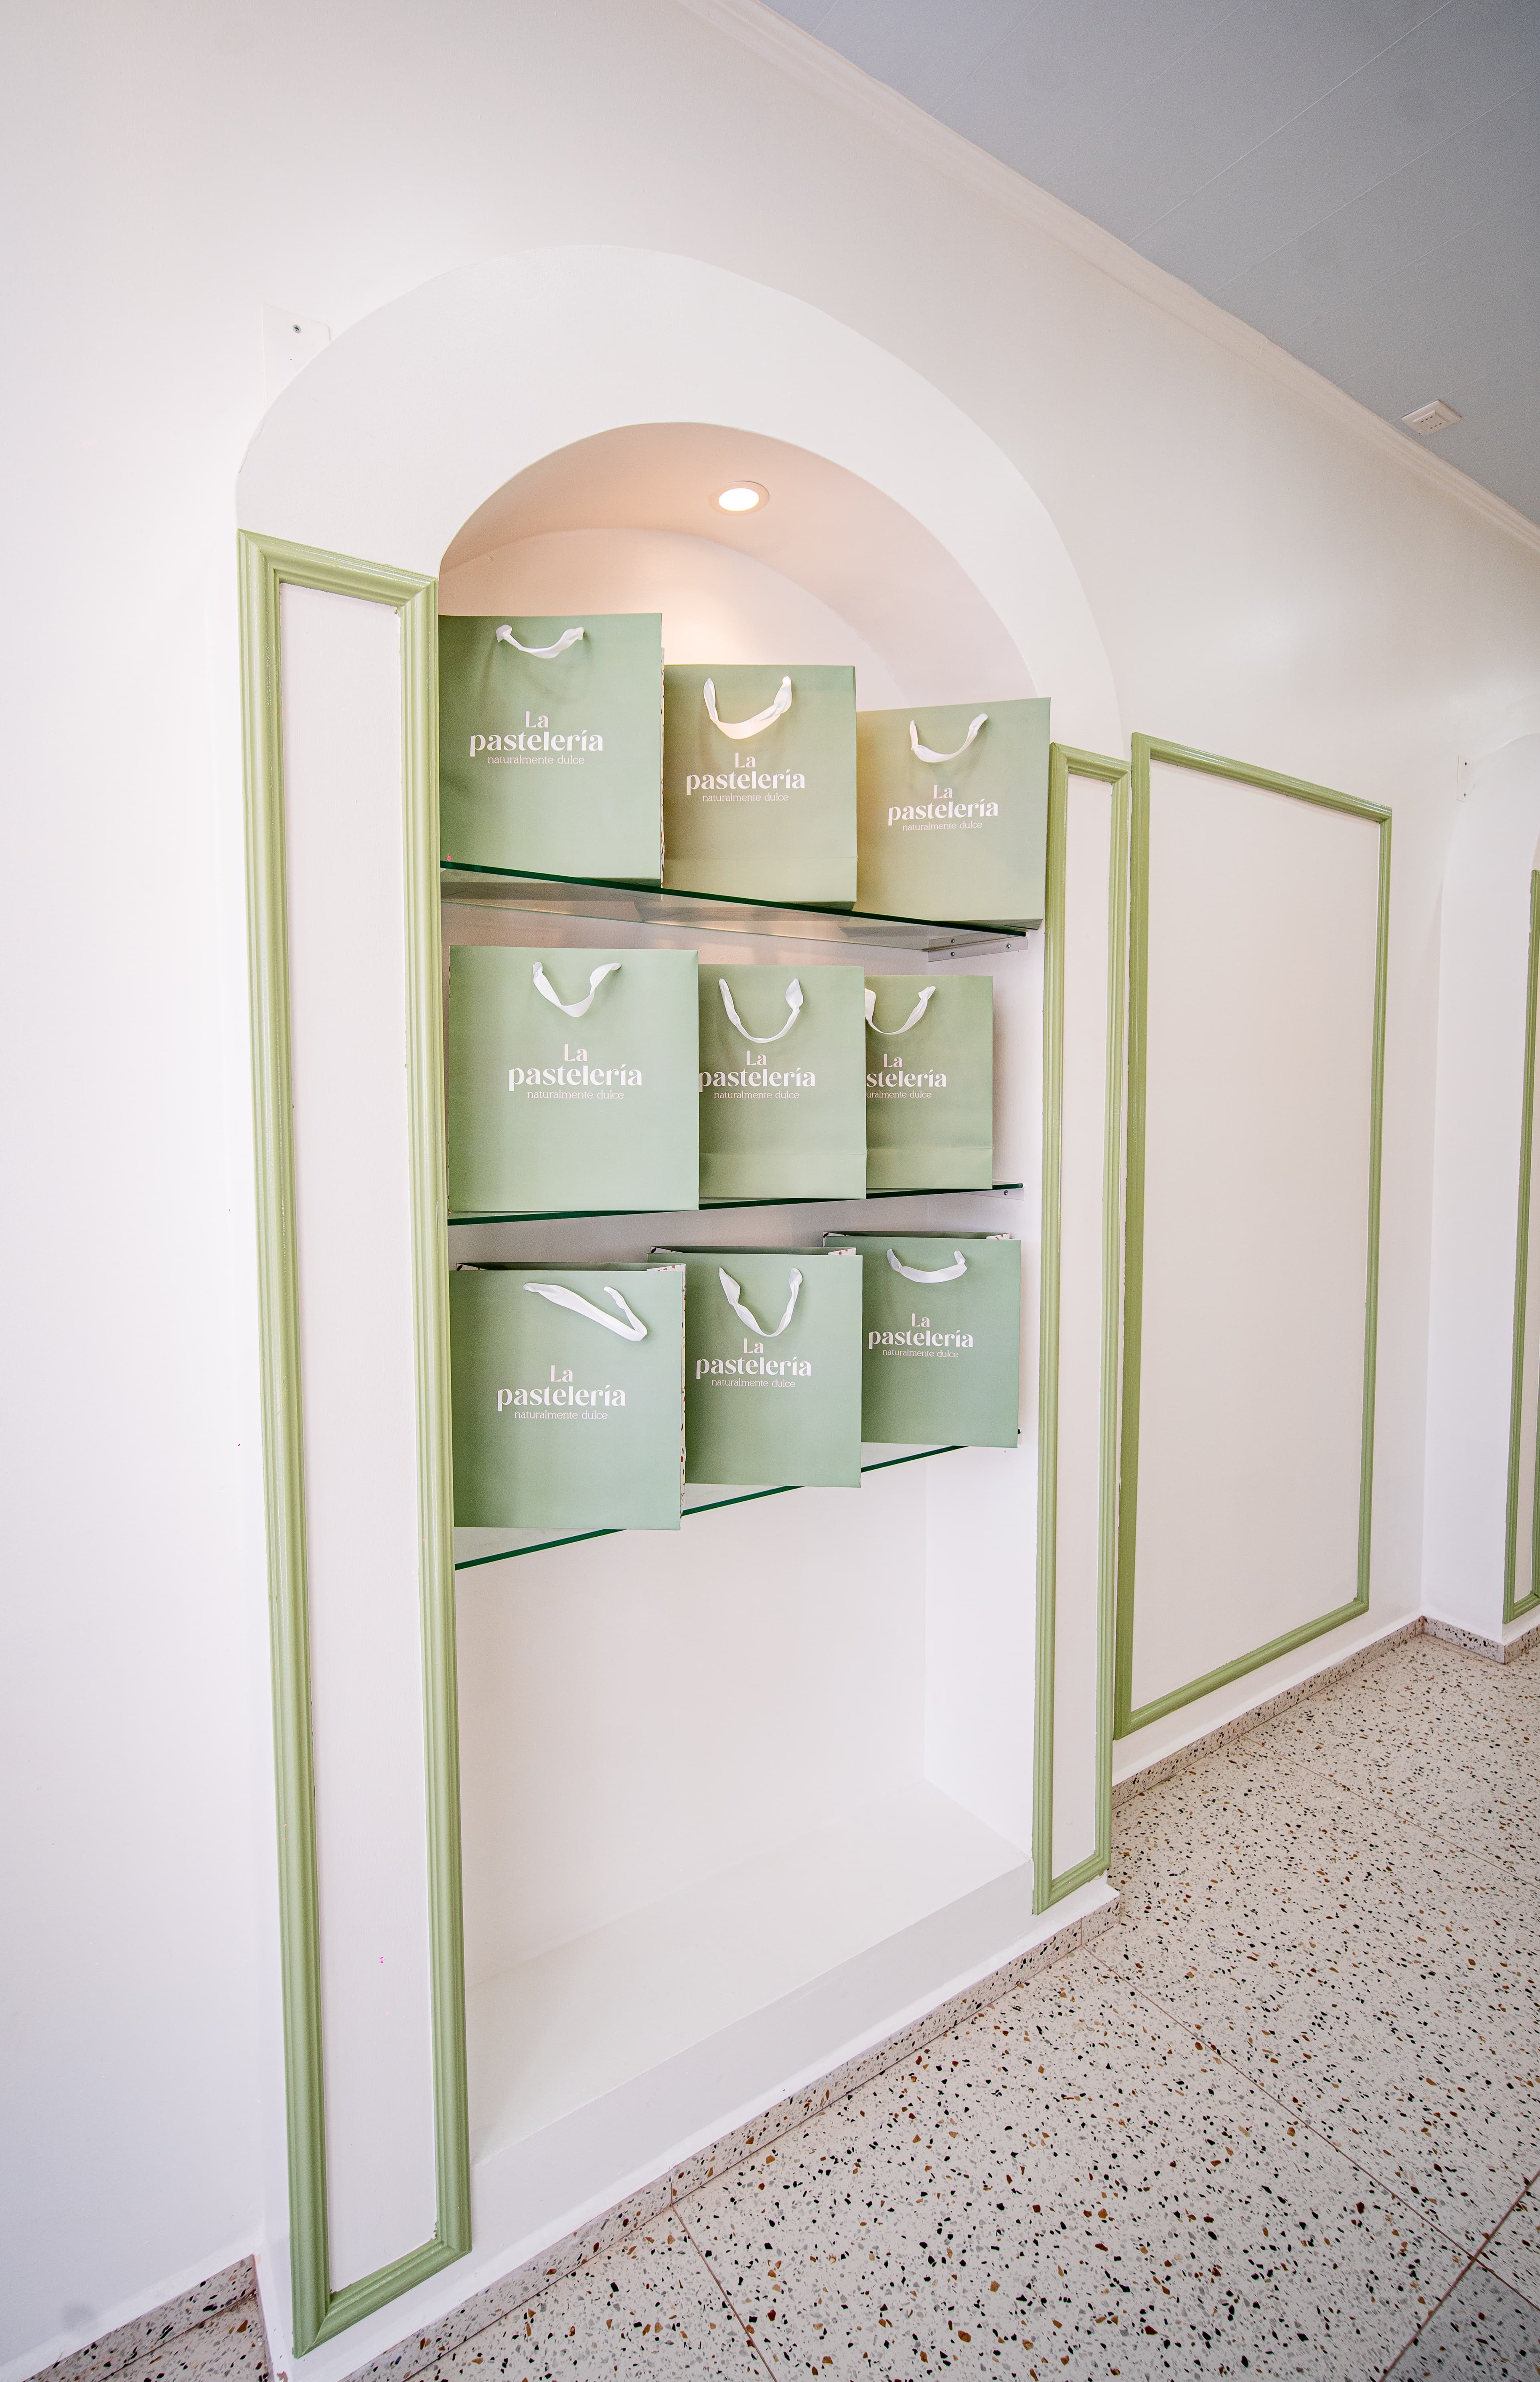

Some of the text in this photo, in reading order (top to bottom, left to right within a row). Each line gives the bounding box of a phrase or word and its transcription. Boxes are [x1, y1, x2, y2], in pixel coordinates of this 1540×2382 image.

[525, 711, 549, 728] La
[470, 730, 603, 757] pastelería
[488, 755, 585, 764] naturalmente dulce
[735, 752, 756, 768] La
[686, 769, 805, 796] pastelería
[702, 792, 789, 802] naturalmente dulce
[933, 784, 953, 799] La
[888, 798, 999, 826] pastelería
[902, 820, 983, 831] naturalmente dulce
[564, 1044, 588, 1061] La
[746, 1050, 767, 1066] La
[883, 1053, 903, 1068] La
[509, 1064, 642, 1091] pastelería
[699, 1067, 816, 1092] pastelería
[866, 1069, 947, 1088] stelería
[527, 1089, 624, 1100] naturalmente dulce
[714, 1090, 799, 1099] naturalmente dulce
[866, 1090, 932, 1098] uralmente dulce
[911, 1313, 930, 1328] La
[744, 1338, 764, 1354] La
[869, 1330, 973, 1349] pastelería
[882, 1349, 959, 1358] naturalmente dulce
[550, 1365, 573, 1383] La
[696, 1357, 812, 1379] pastelería
[711, 1378, 796, 1388] naturalmente dulce
[497, 1385, 626, 1412] pastelería
[514, 1410, 608, 1420] naturalmente dulce
